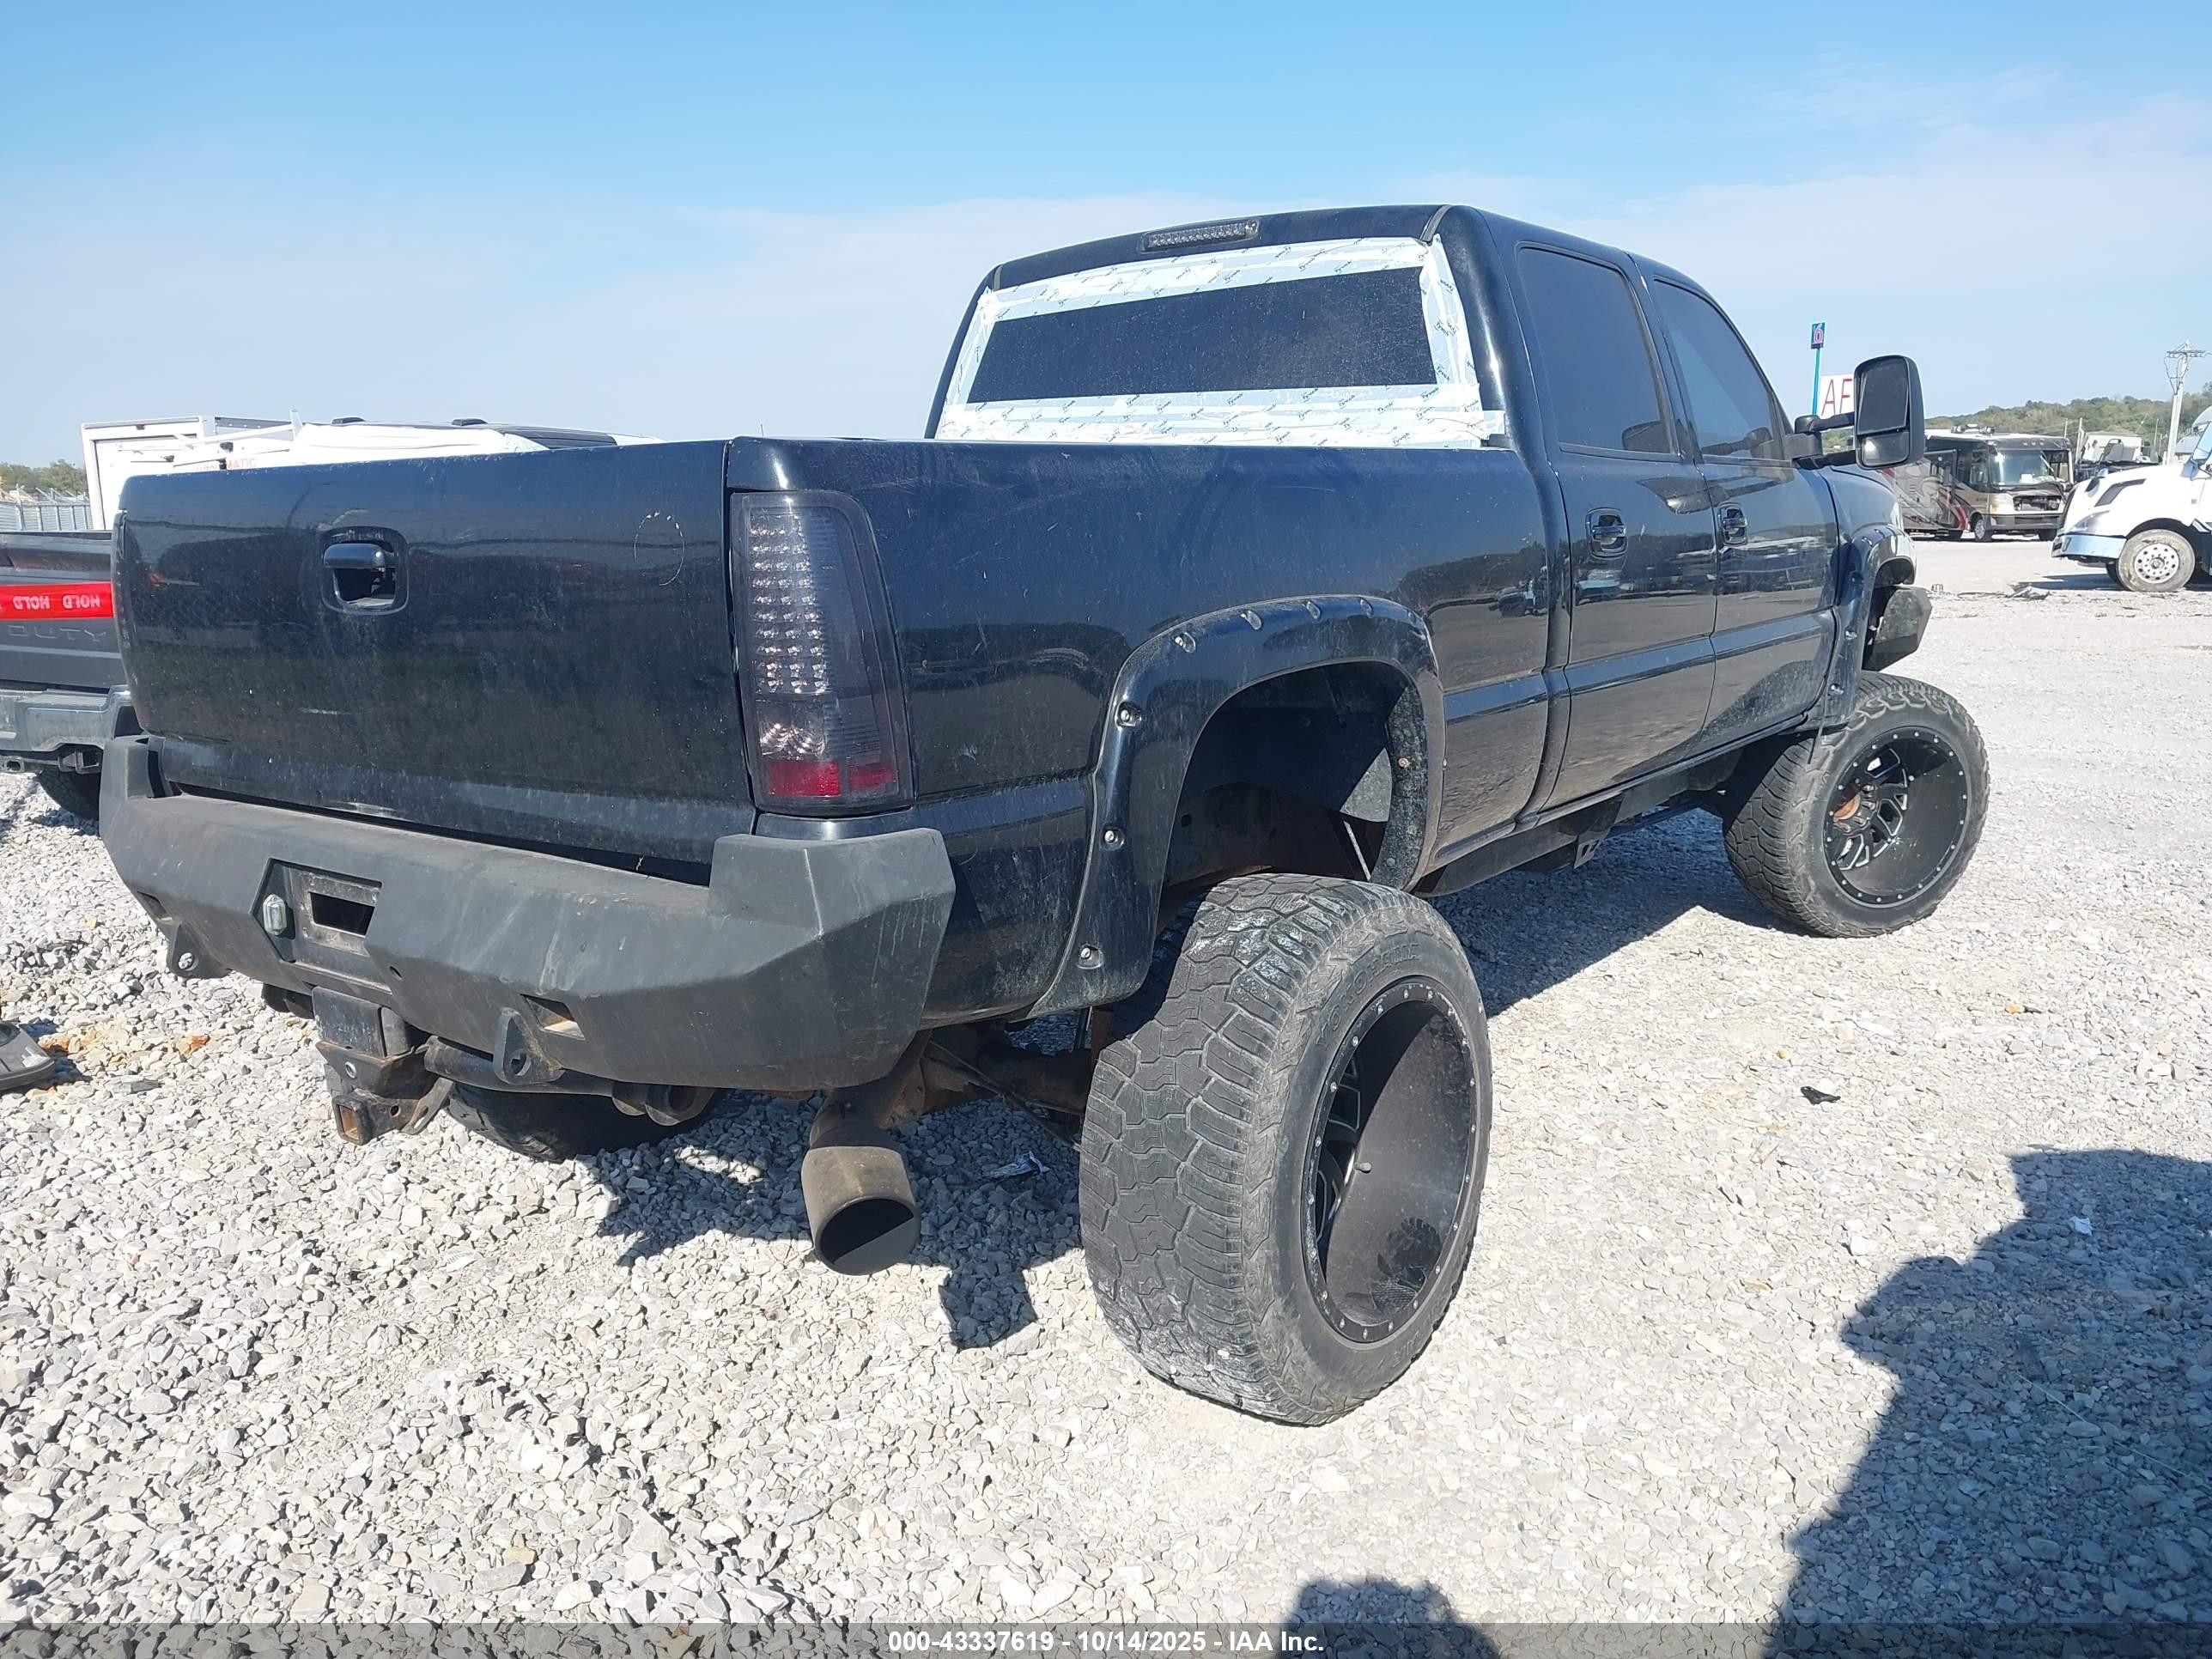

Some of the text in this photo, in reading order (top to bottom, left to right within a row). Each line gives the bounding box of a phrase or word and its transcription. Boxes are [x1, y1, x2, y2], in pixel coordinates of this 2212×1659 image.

[13, 595, 51, 610] HOLD
[62, 594, 100, 610] HOLD
[8, 624, 106, 642] DUTY
